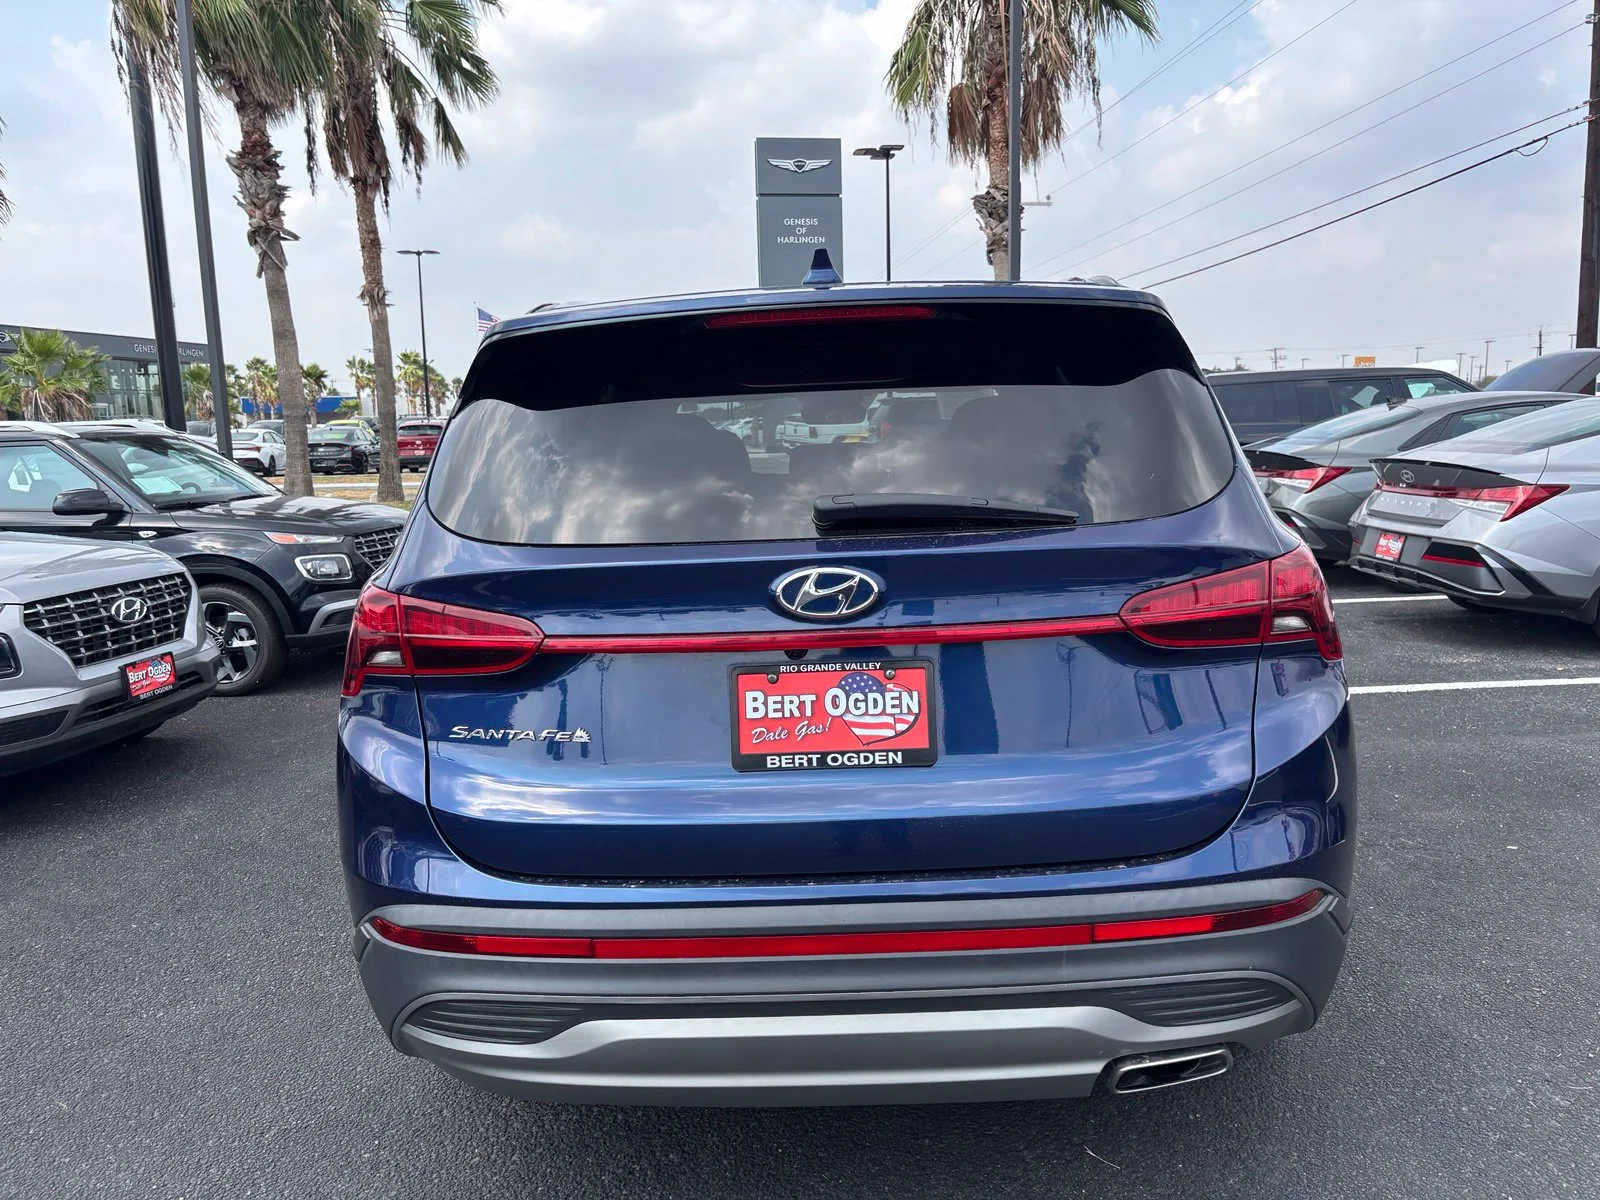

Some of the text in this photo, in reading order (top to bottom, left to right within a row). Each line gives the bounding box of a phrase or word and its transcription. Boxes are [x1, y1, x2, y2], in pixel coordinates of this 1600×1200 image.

[784, 218, 818, 226] GENESIS
[795, 227, 807, 235] OF
[134, 344, 204, 357] GENESI RLINGEN
[129, 670, 147, 684] BERT
[148, 662, 171, 677] OGDEN
[780, 662, 881, 673] RIO GRANDE VALLEY
[744, 687, 919, 719] BERT OGDEN
[751, 717, 832, 744] Dale Gas!
[766, 751, 903, 768] BERT OGDEN
